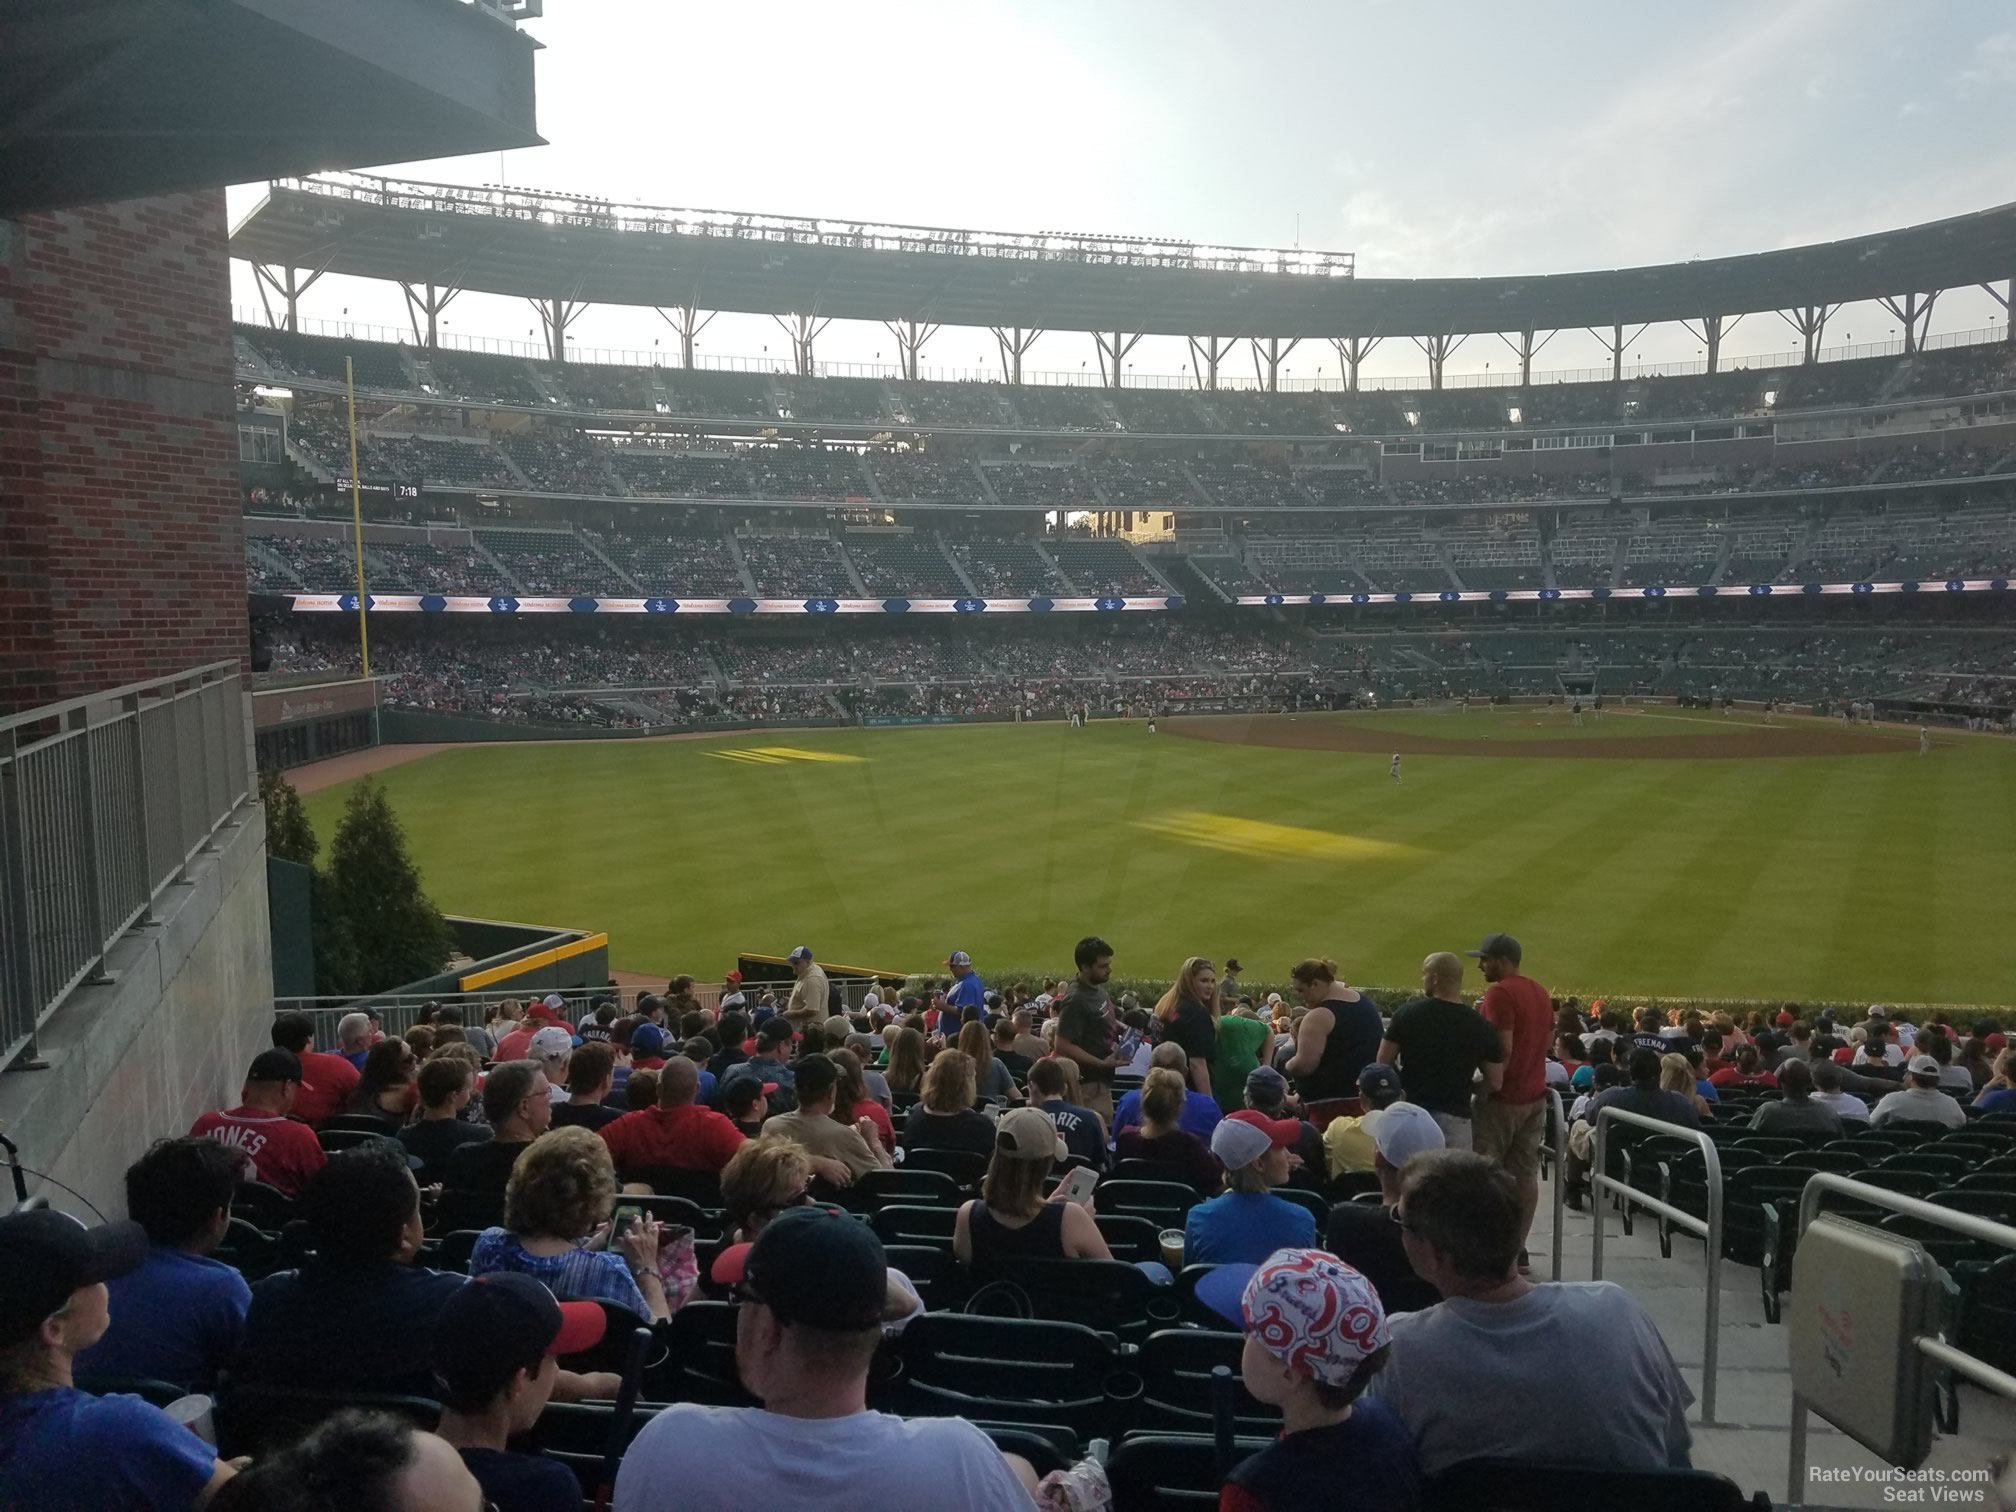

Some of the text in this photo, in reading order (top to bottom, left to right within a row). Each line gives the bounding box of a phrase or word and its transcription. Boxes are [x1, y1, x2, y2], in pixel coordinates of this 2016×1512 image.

[400, 485, 418, 497] 7:18
[1633, 1038, 1667, 1051] FREEMAN
[1048, 1111, 1083, 1131] ARTE
